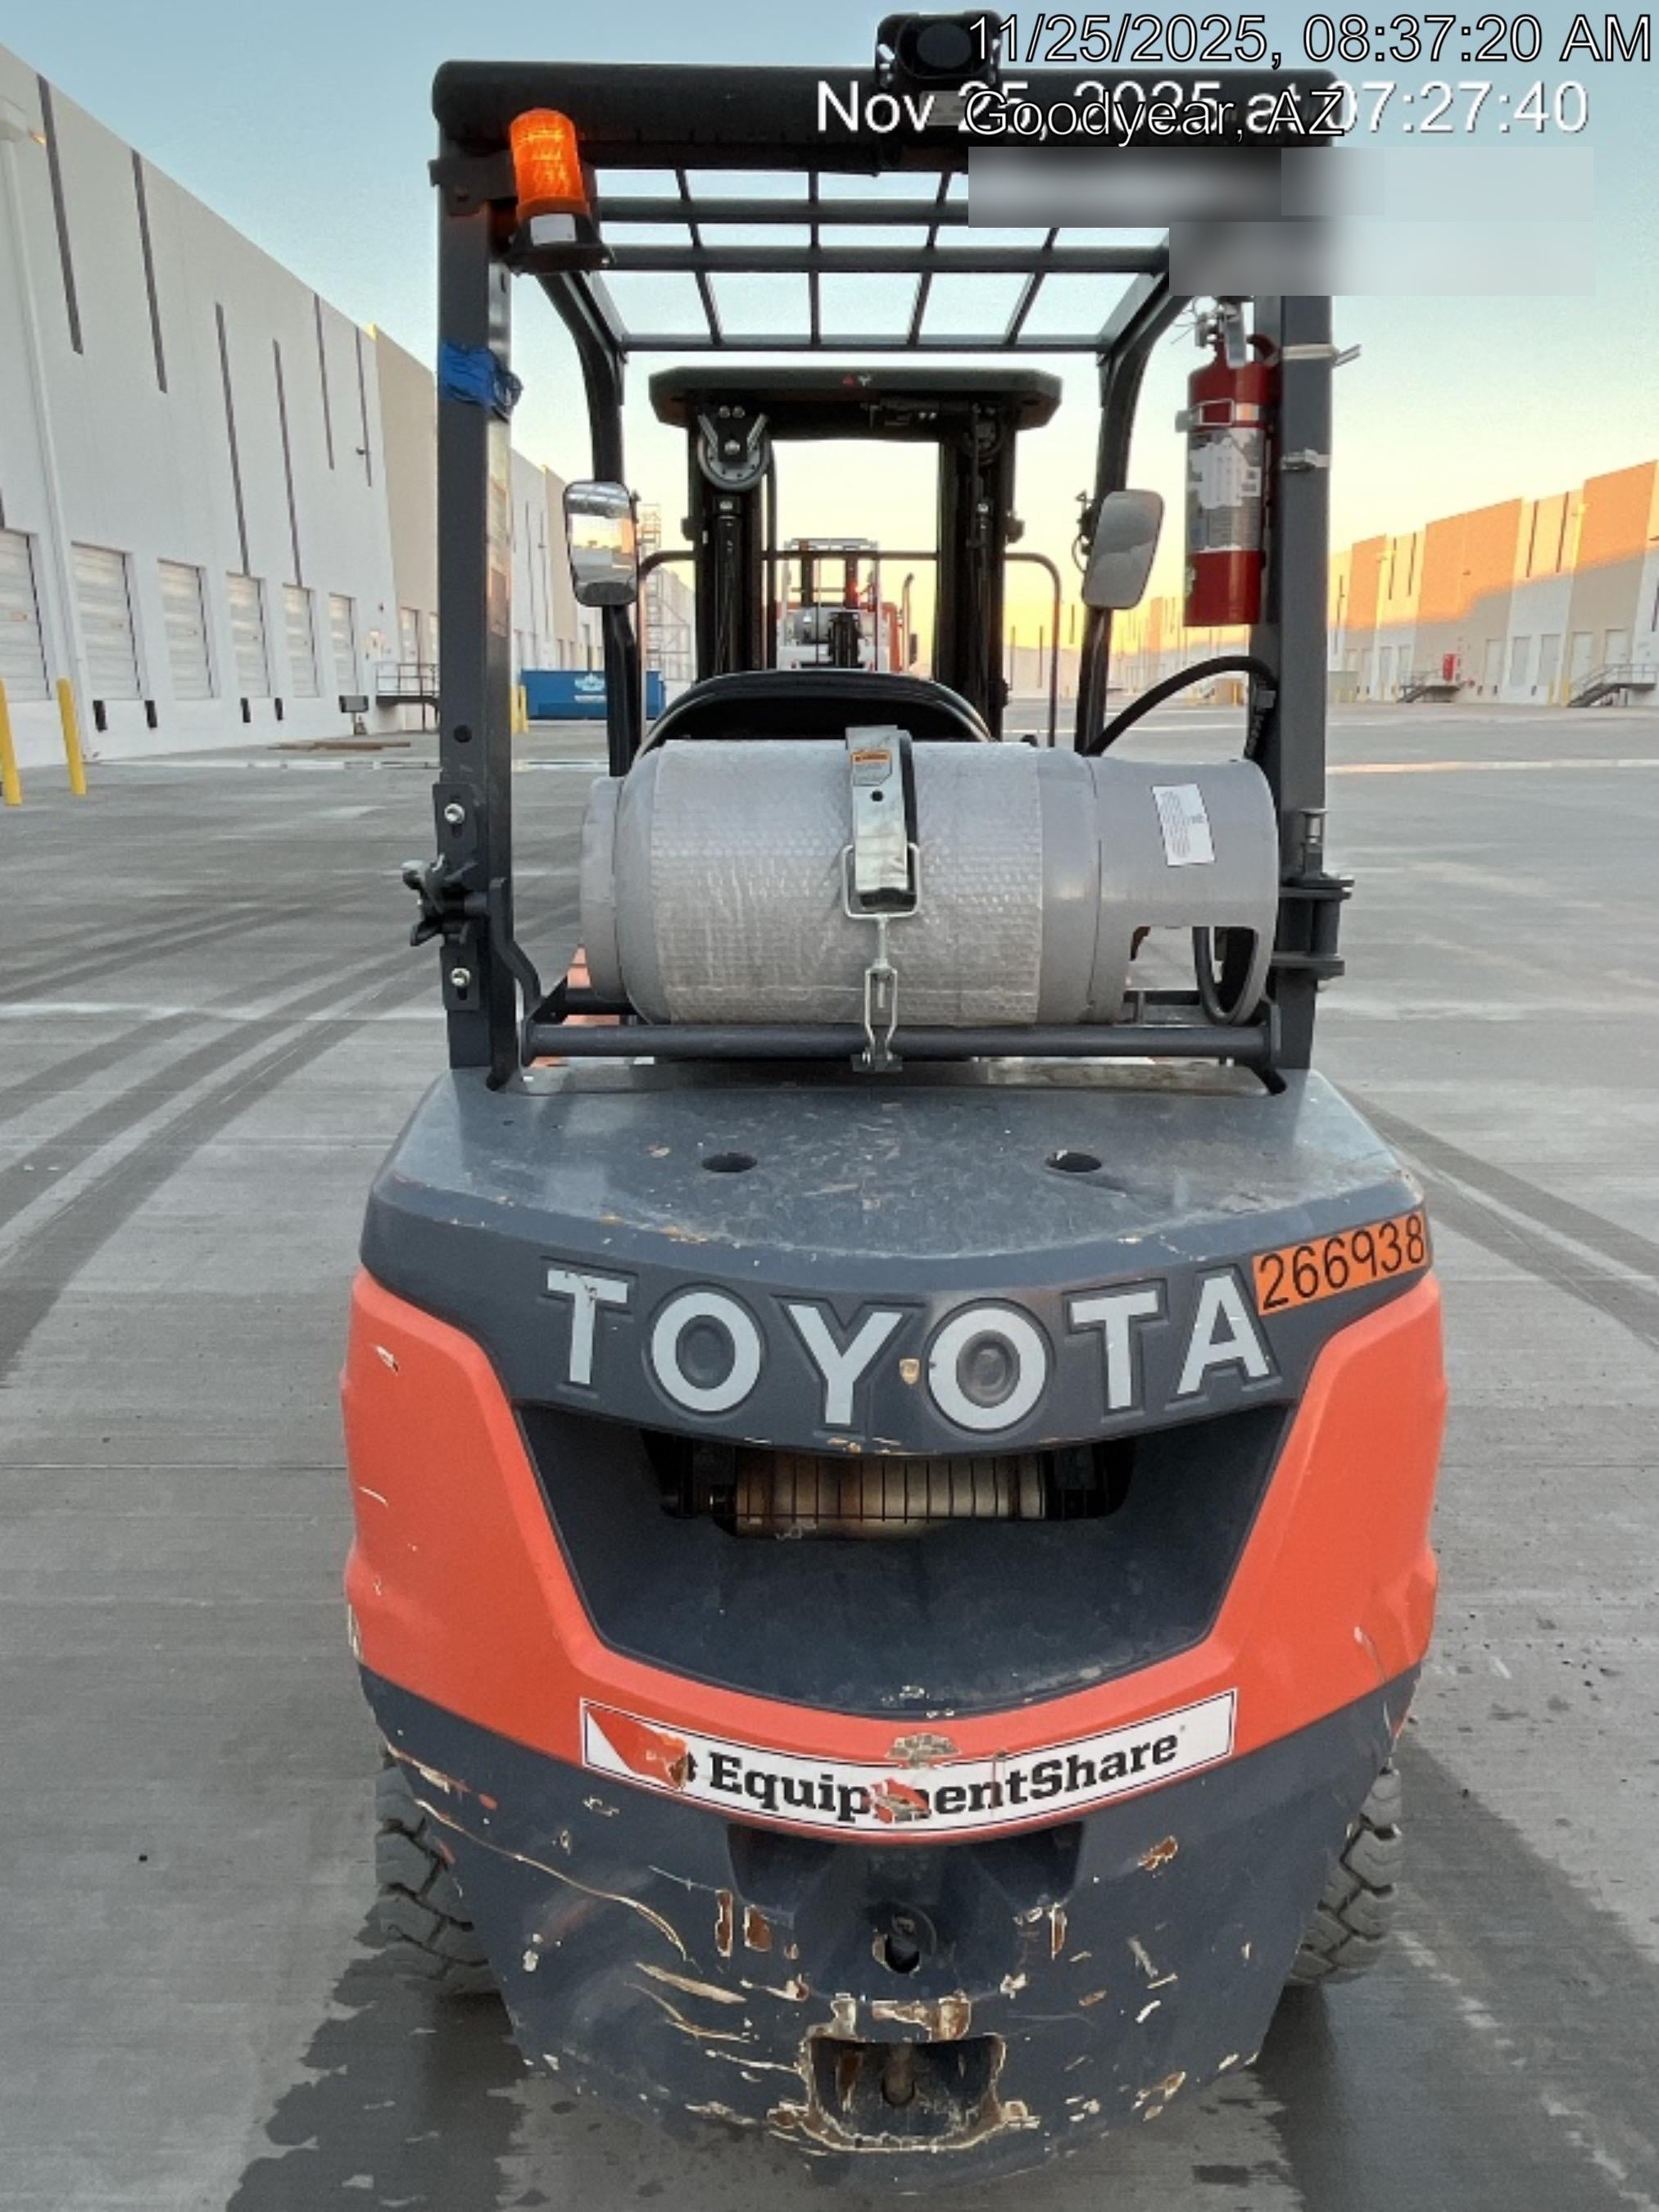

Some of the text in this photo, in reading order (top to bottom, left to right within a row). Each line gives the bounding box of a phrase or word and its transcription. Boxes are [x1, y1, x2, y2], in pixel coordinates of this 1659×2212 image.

[1258, 1214, 1426, 1310] 266938
[546, 1267, 1271, 1432] TOYOTA
[709, 1734, 1178, 1824] EquipentShare
